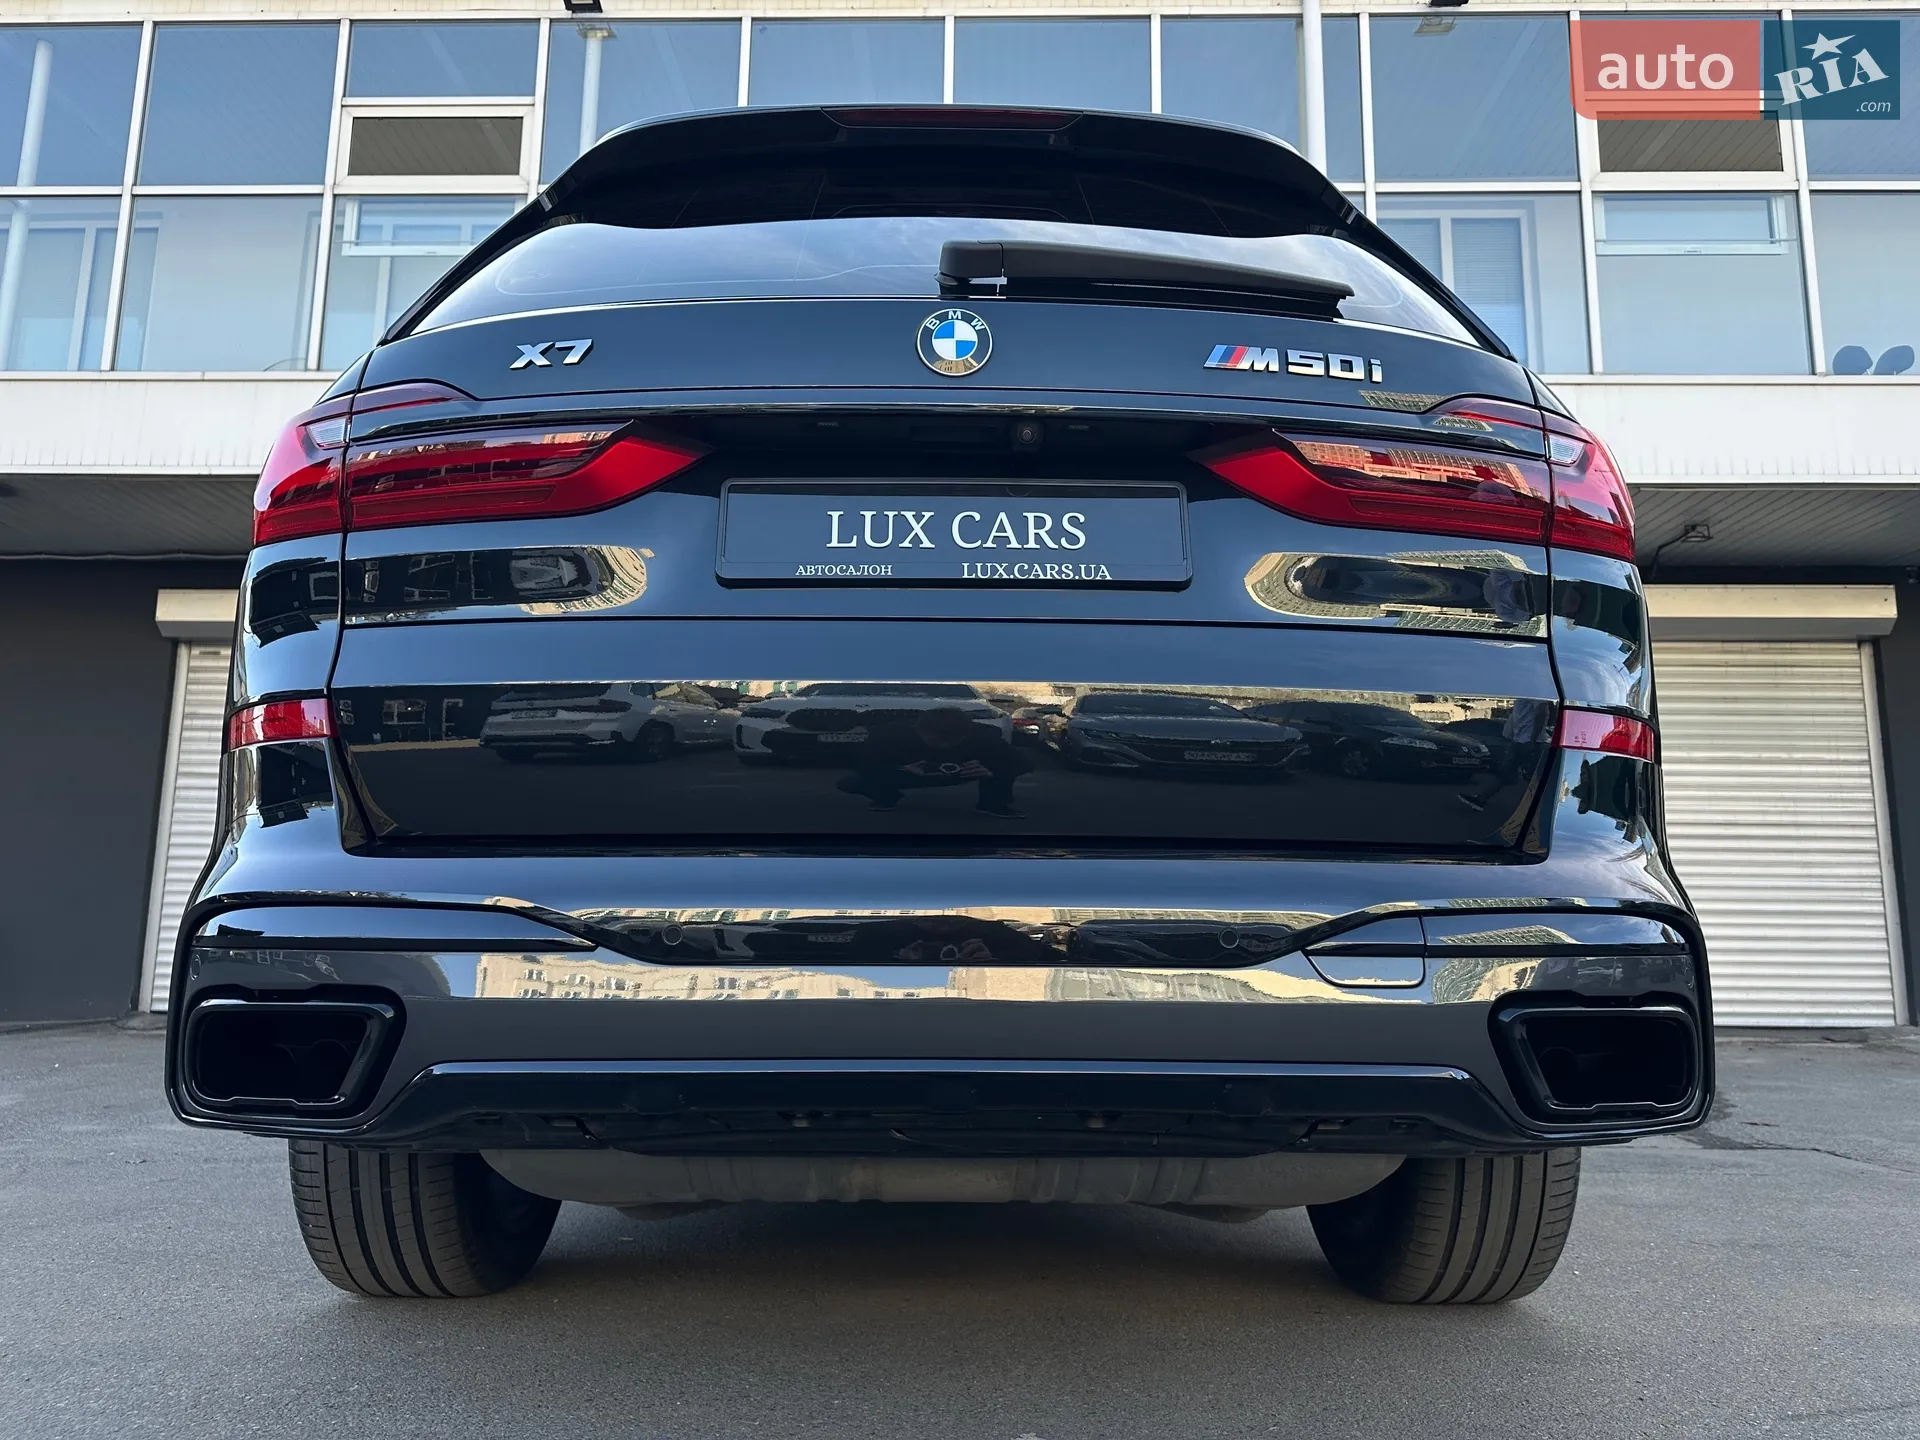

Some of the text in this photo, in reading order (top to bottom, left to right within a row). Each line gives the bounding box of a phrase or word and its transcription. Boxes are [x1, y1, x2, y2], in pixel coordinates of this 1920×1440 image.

[925, 310, 986, 331] BMW
[509, 338, 594, 370] X7
[826, 510, 1087, 550] LUX CARS
[795, 564, 893, 577] АВТОСАЛОН
[961, 562, 1112, 581] LUX.CARS.UA
